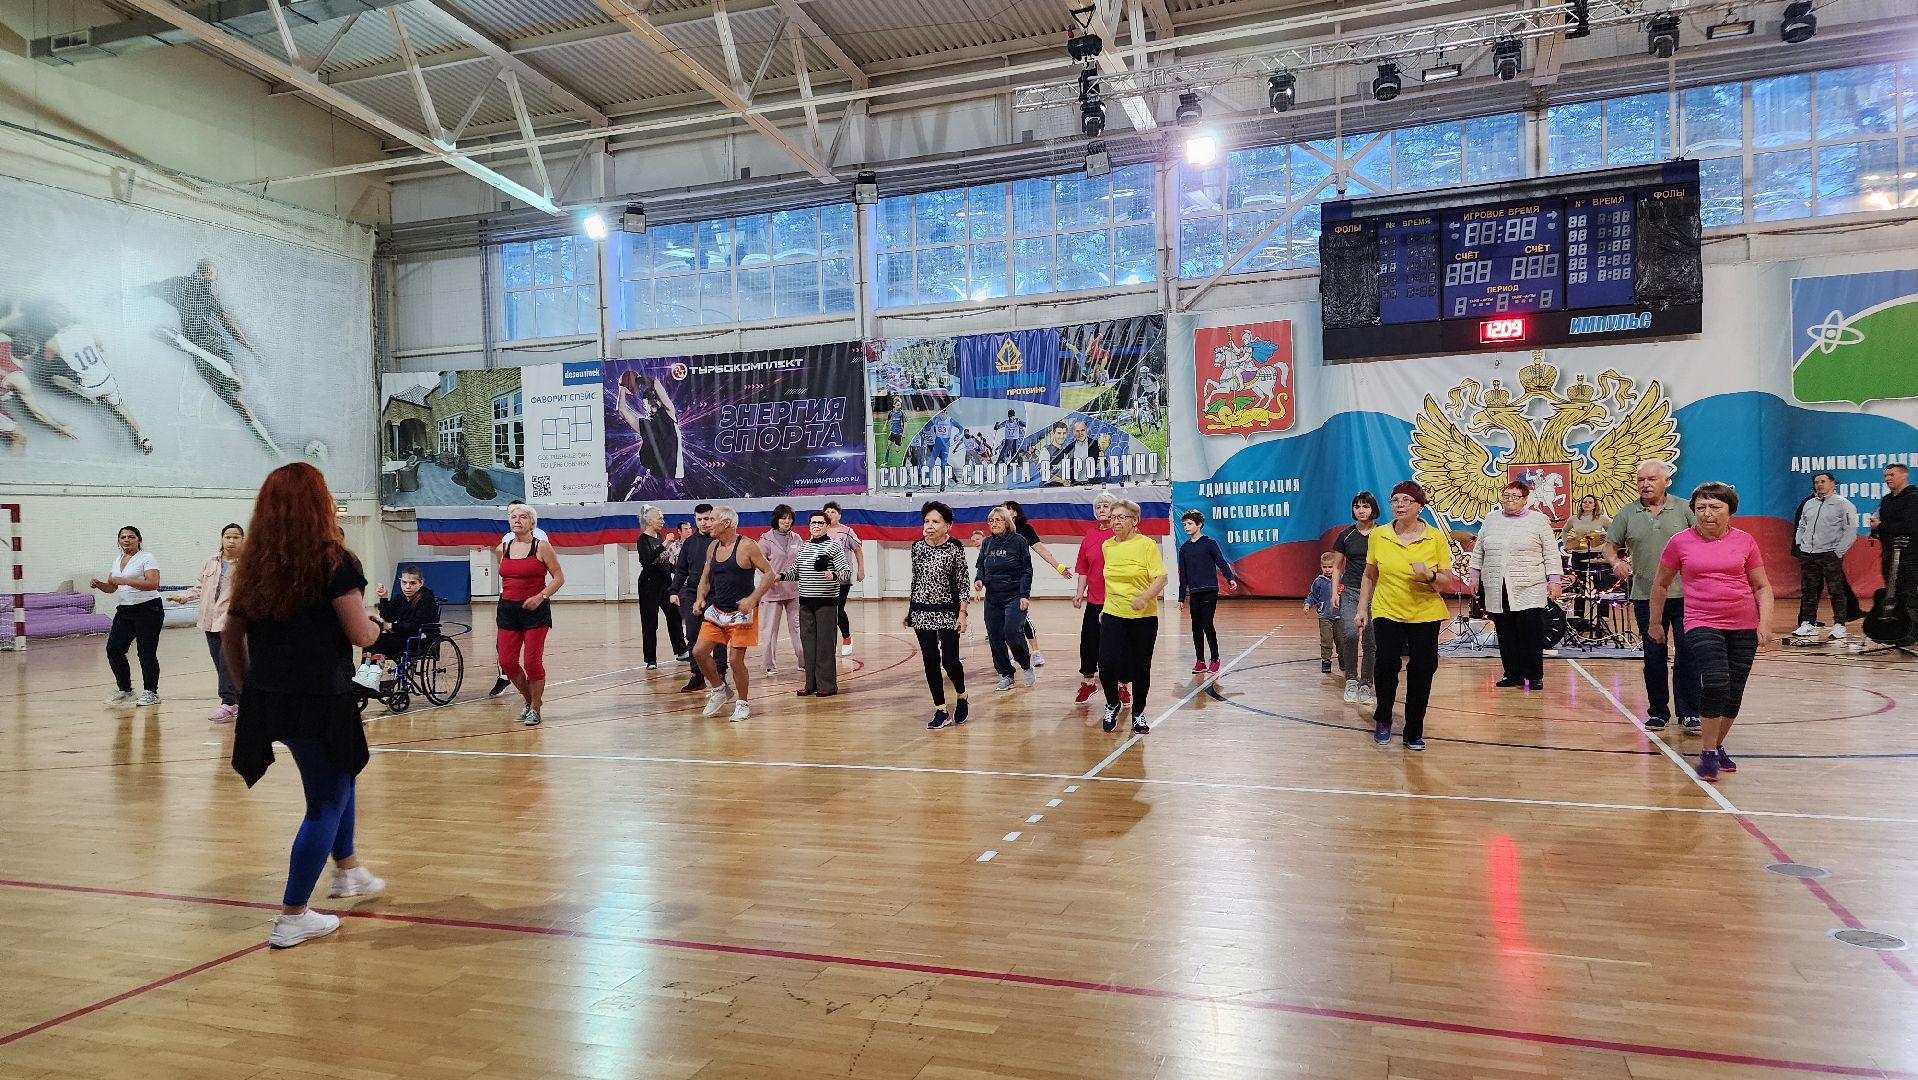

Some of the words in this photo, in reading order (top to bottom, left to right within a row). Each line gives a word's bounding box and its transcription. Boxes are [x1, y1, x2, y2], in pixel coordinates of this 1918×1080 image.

[1592, 196, 1625, 206] ВРЕМЯ
[1654, 189, 1685, 199] ФОЛЫ
[1463, 209, 1505, 221] ИГРОВОЕ
[1508, 205, 1540, 216] ВРЕМЯ
[1334, 224, 1362, 233] ФОЛЫ
[1402, 218, 1431, 227] ВРЕМЯ
[1487, 284, 1519, 293] ПЕРИОД
[1569, 312, 1652, 334] ИМПУЛЬС
[75, 345, 98, 370] 10
[689, 358, 804, 375] ТУРБОКОМПЛЕКТ
[1007, 386, 1047, 396] ПРОТВИНО
[530, 395, 568, 404] ФАВОРИТ
[719, 397, 847, 428] ЭНЕРГИЯ
[714, 422, 843, 453] СПОРТА
[880, 465, 953, 487] СПОНСОР
[963, 460, 1031, 484] СПОРТА
[1041, 461, 1051, 481] В
[1061, 453, 1158, 479] ПРОТВИНО
[1199, 479, 1300, 497] АДМИНИСТРАЦИЯ
[1837, 482, 1891, 499] ОРОД
[1212, 501, 1290, 519] МОСКОВСКОЙ
[1227, 528, 1279, 543] ОБЛАСТИ
